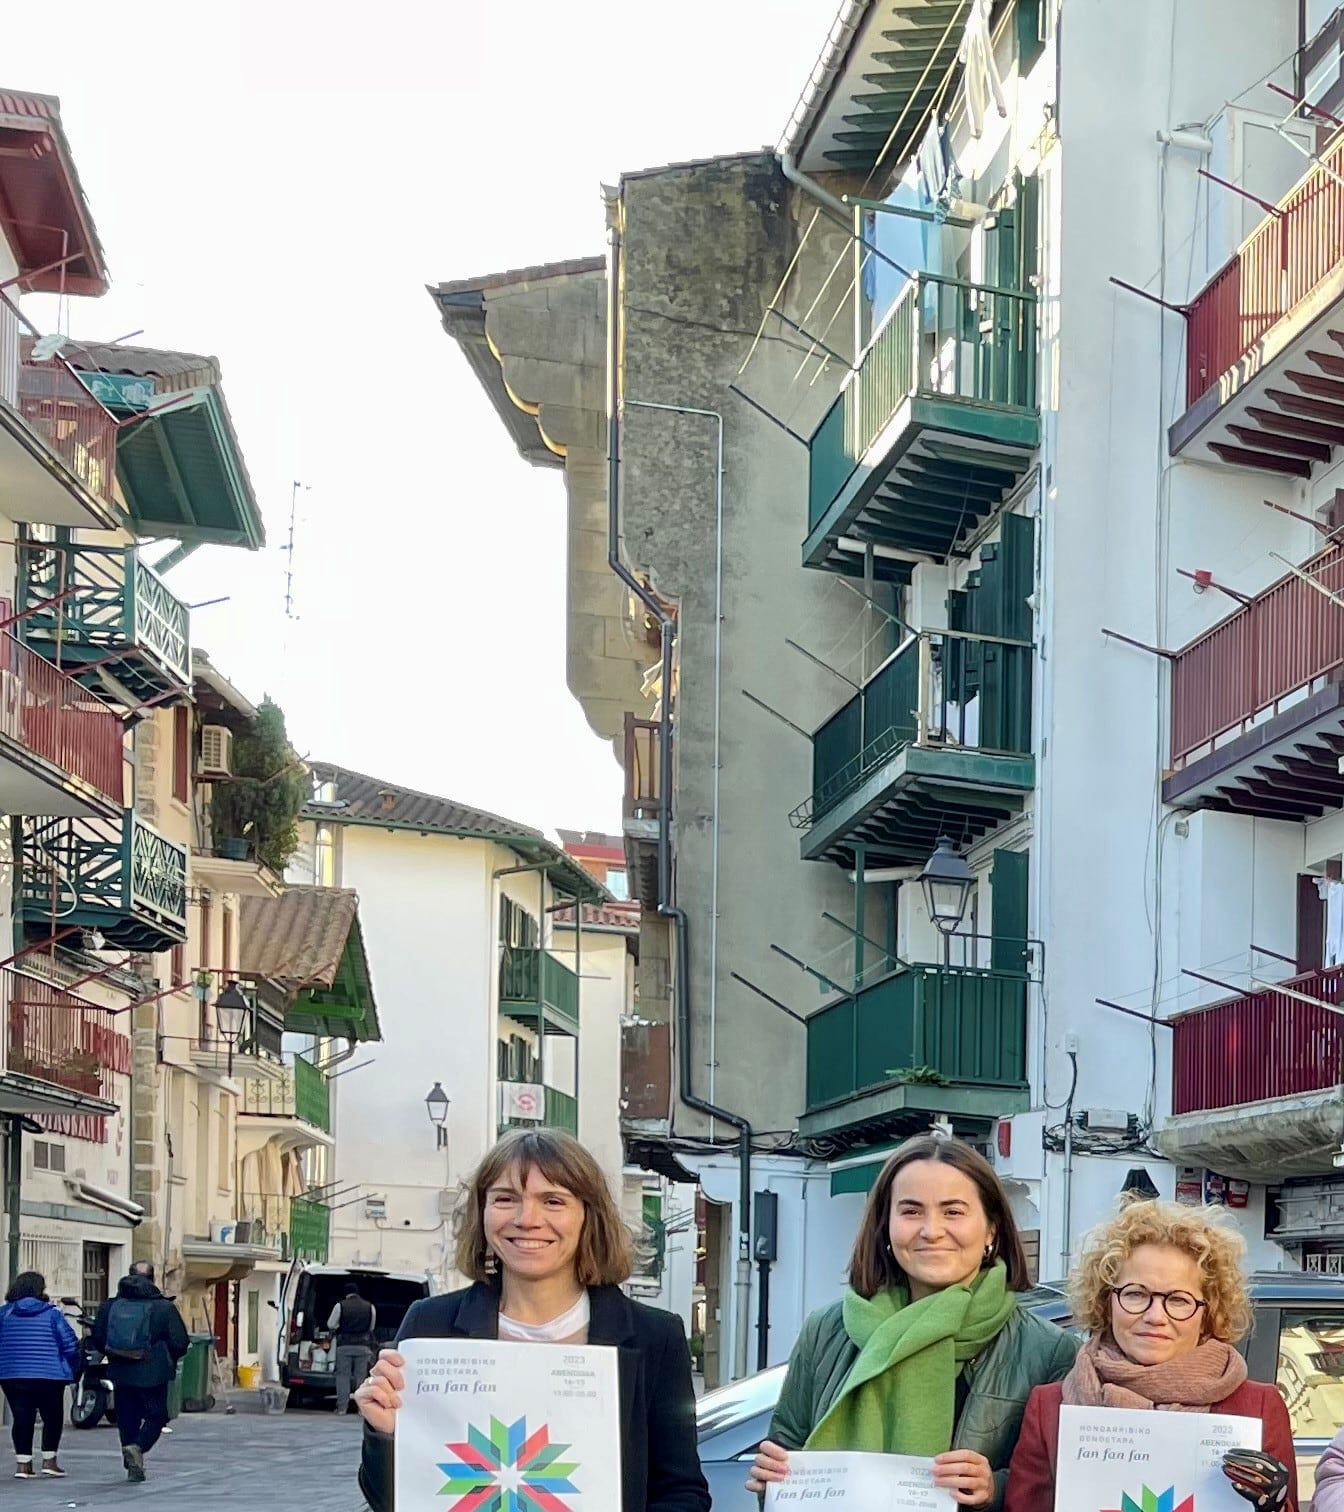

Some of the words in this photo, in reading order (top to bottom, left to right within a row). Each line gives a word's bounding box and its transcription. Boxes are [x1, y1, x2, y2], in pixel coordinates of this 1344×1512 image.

[416, 1380, 440, 1395] fan
[444, 1380, 469, 1395] fan
[472, 1380, 497, 1395] fan
[1077, 1446, 1099, 1460] fan
[1102, 1447, 1125, 1461] fan
[1128, 1449, 1150, 1463] fan
[775, 1488, 798, 1501] fan
[800, 1487, 821, 1501] fan
[823, 1486, 846, 1500] fan
